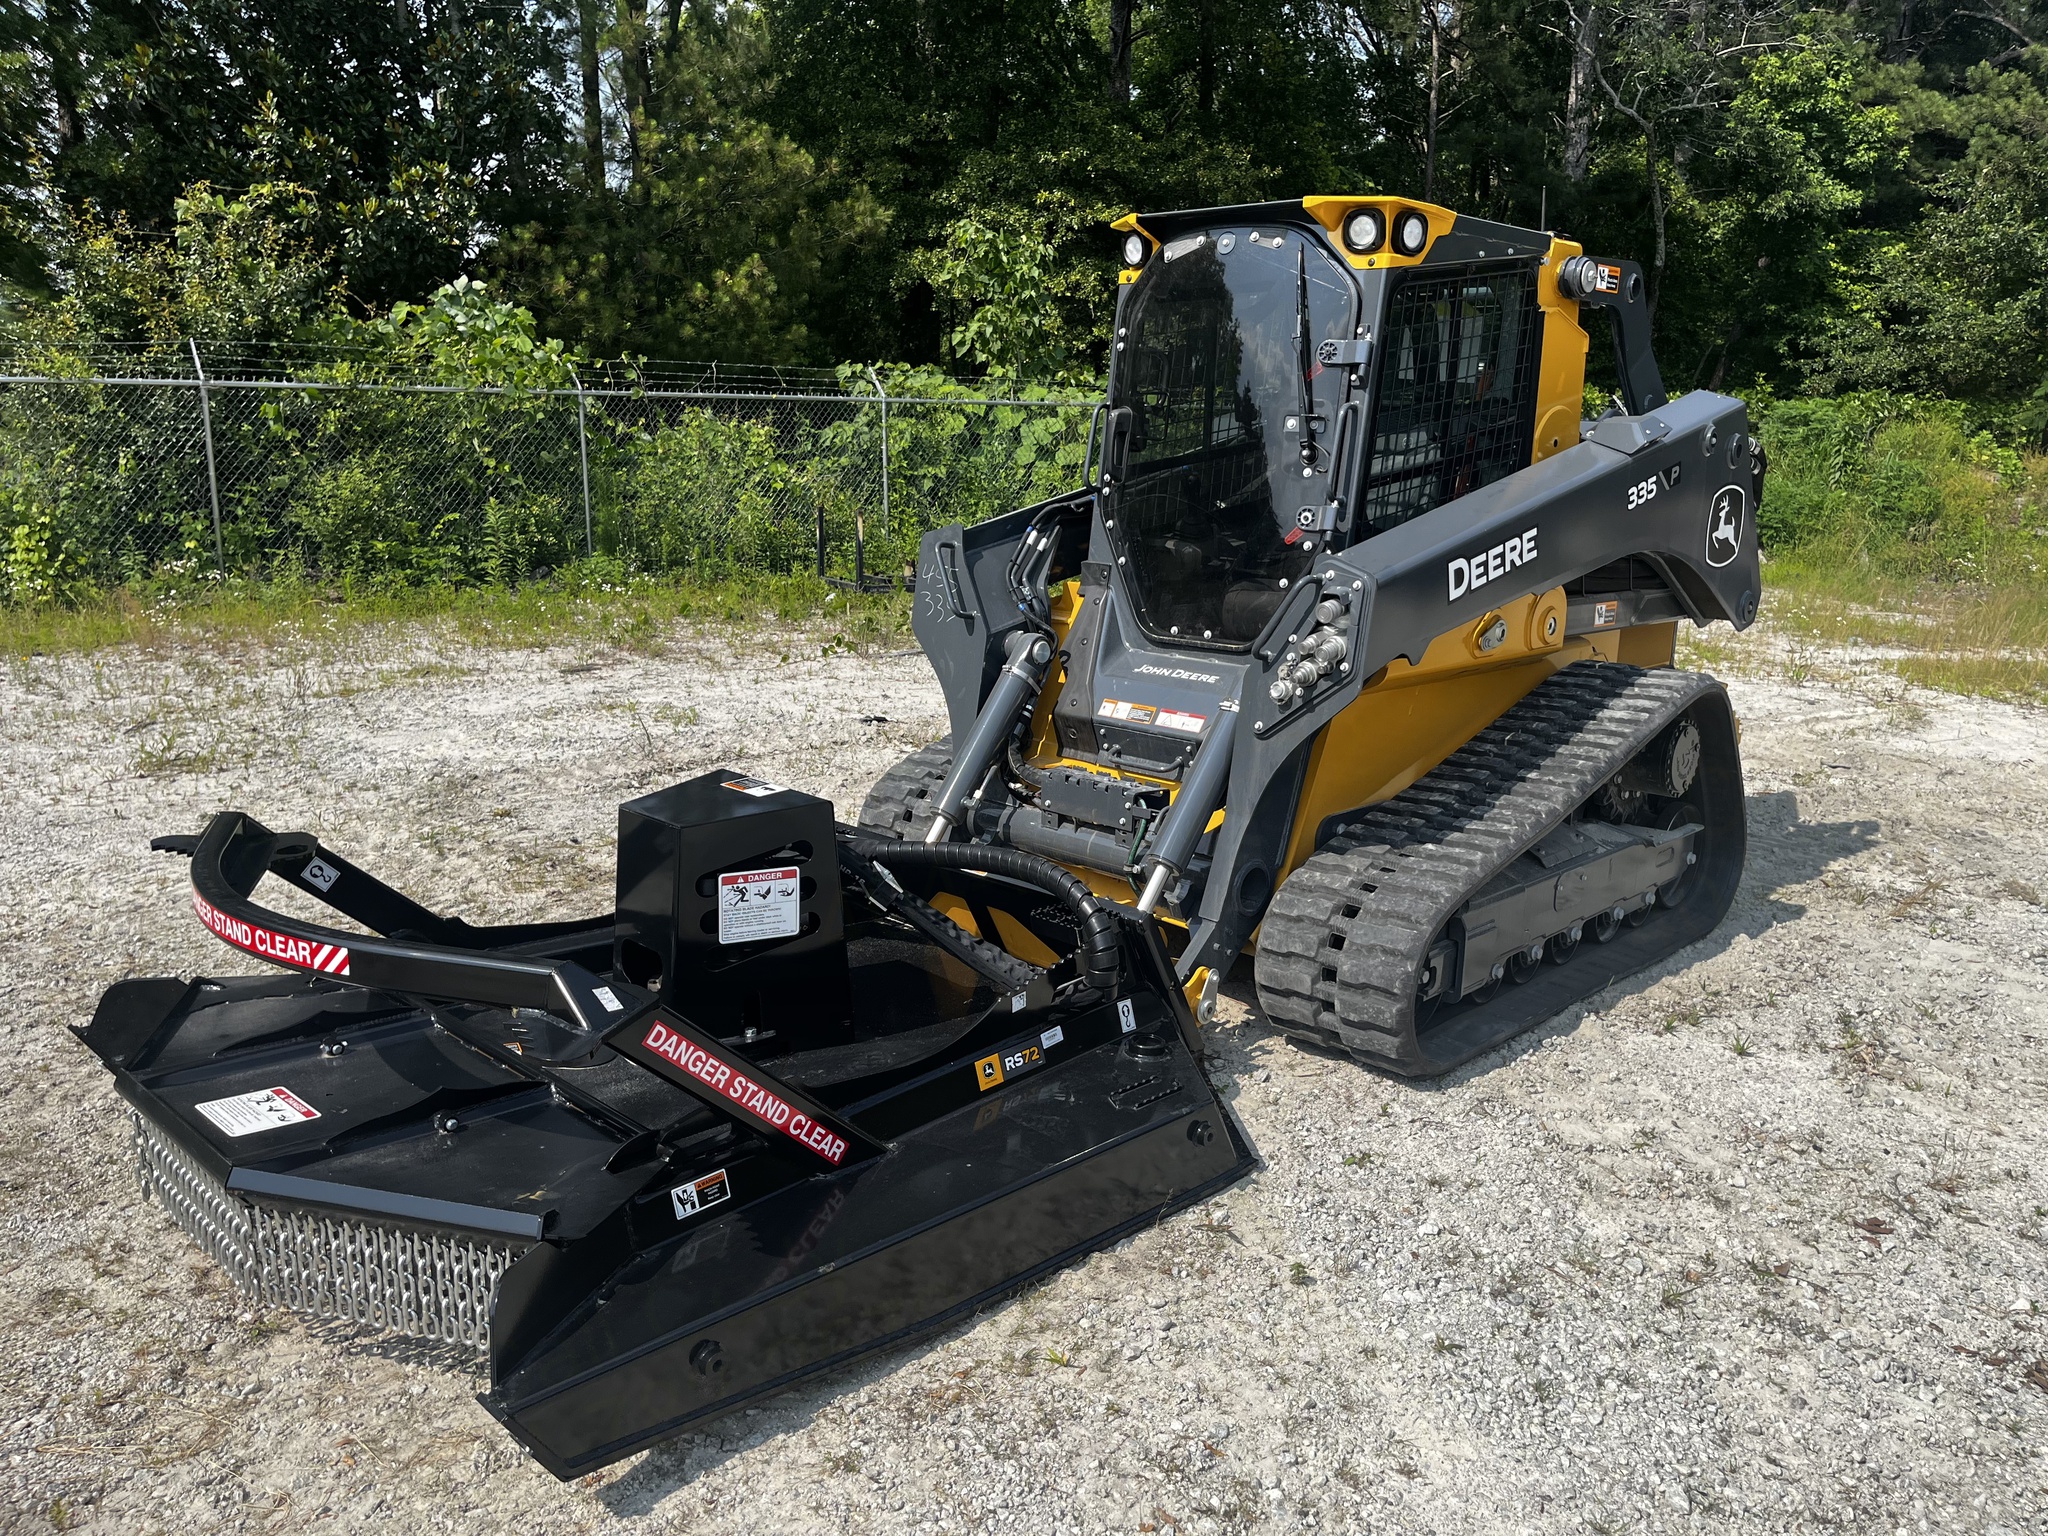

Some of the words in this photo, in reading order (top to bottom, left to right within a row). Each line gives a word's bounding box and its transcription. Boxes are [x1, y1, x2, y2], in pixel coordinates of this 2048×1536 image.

[1627, 476, 1657, 510] 335
[1448, 527, 1538, 601] DEERE
[1133, 664, 1172, 677] JOHN
[1171, 669, 1220, 684] DEERE
[748, 872, 783, 882] DANGER
[213, 910, 251, 946] STAND
[255, 930, 312, 964] CLEAR
[1004, 1046, 1040, 1071] RS72
[646, 1024, 731, 1089] DANGER
[729, 1077, 790, 1125] STAND
[789, 1115, 846, 1161] CLEAR
[701, 1174, 723, 1186] WARNING
